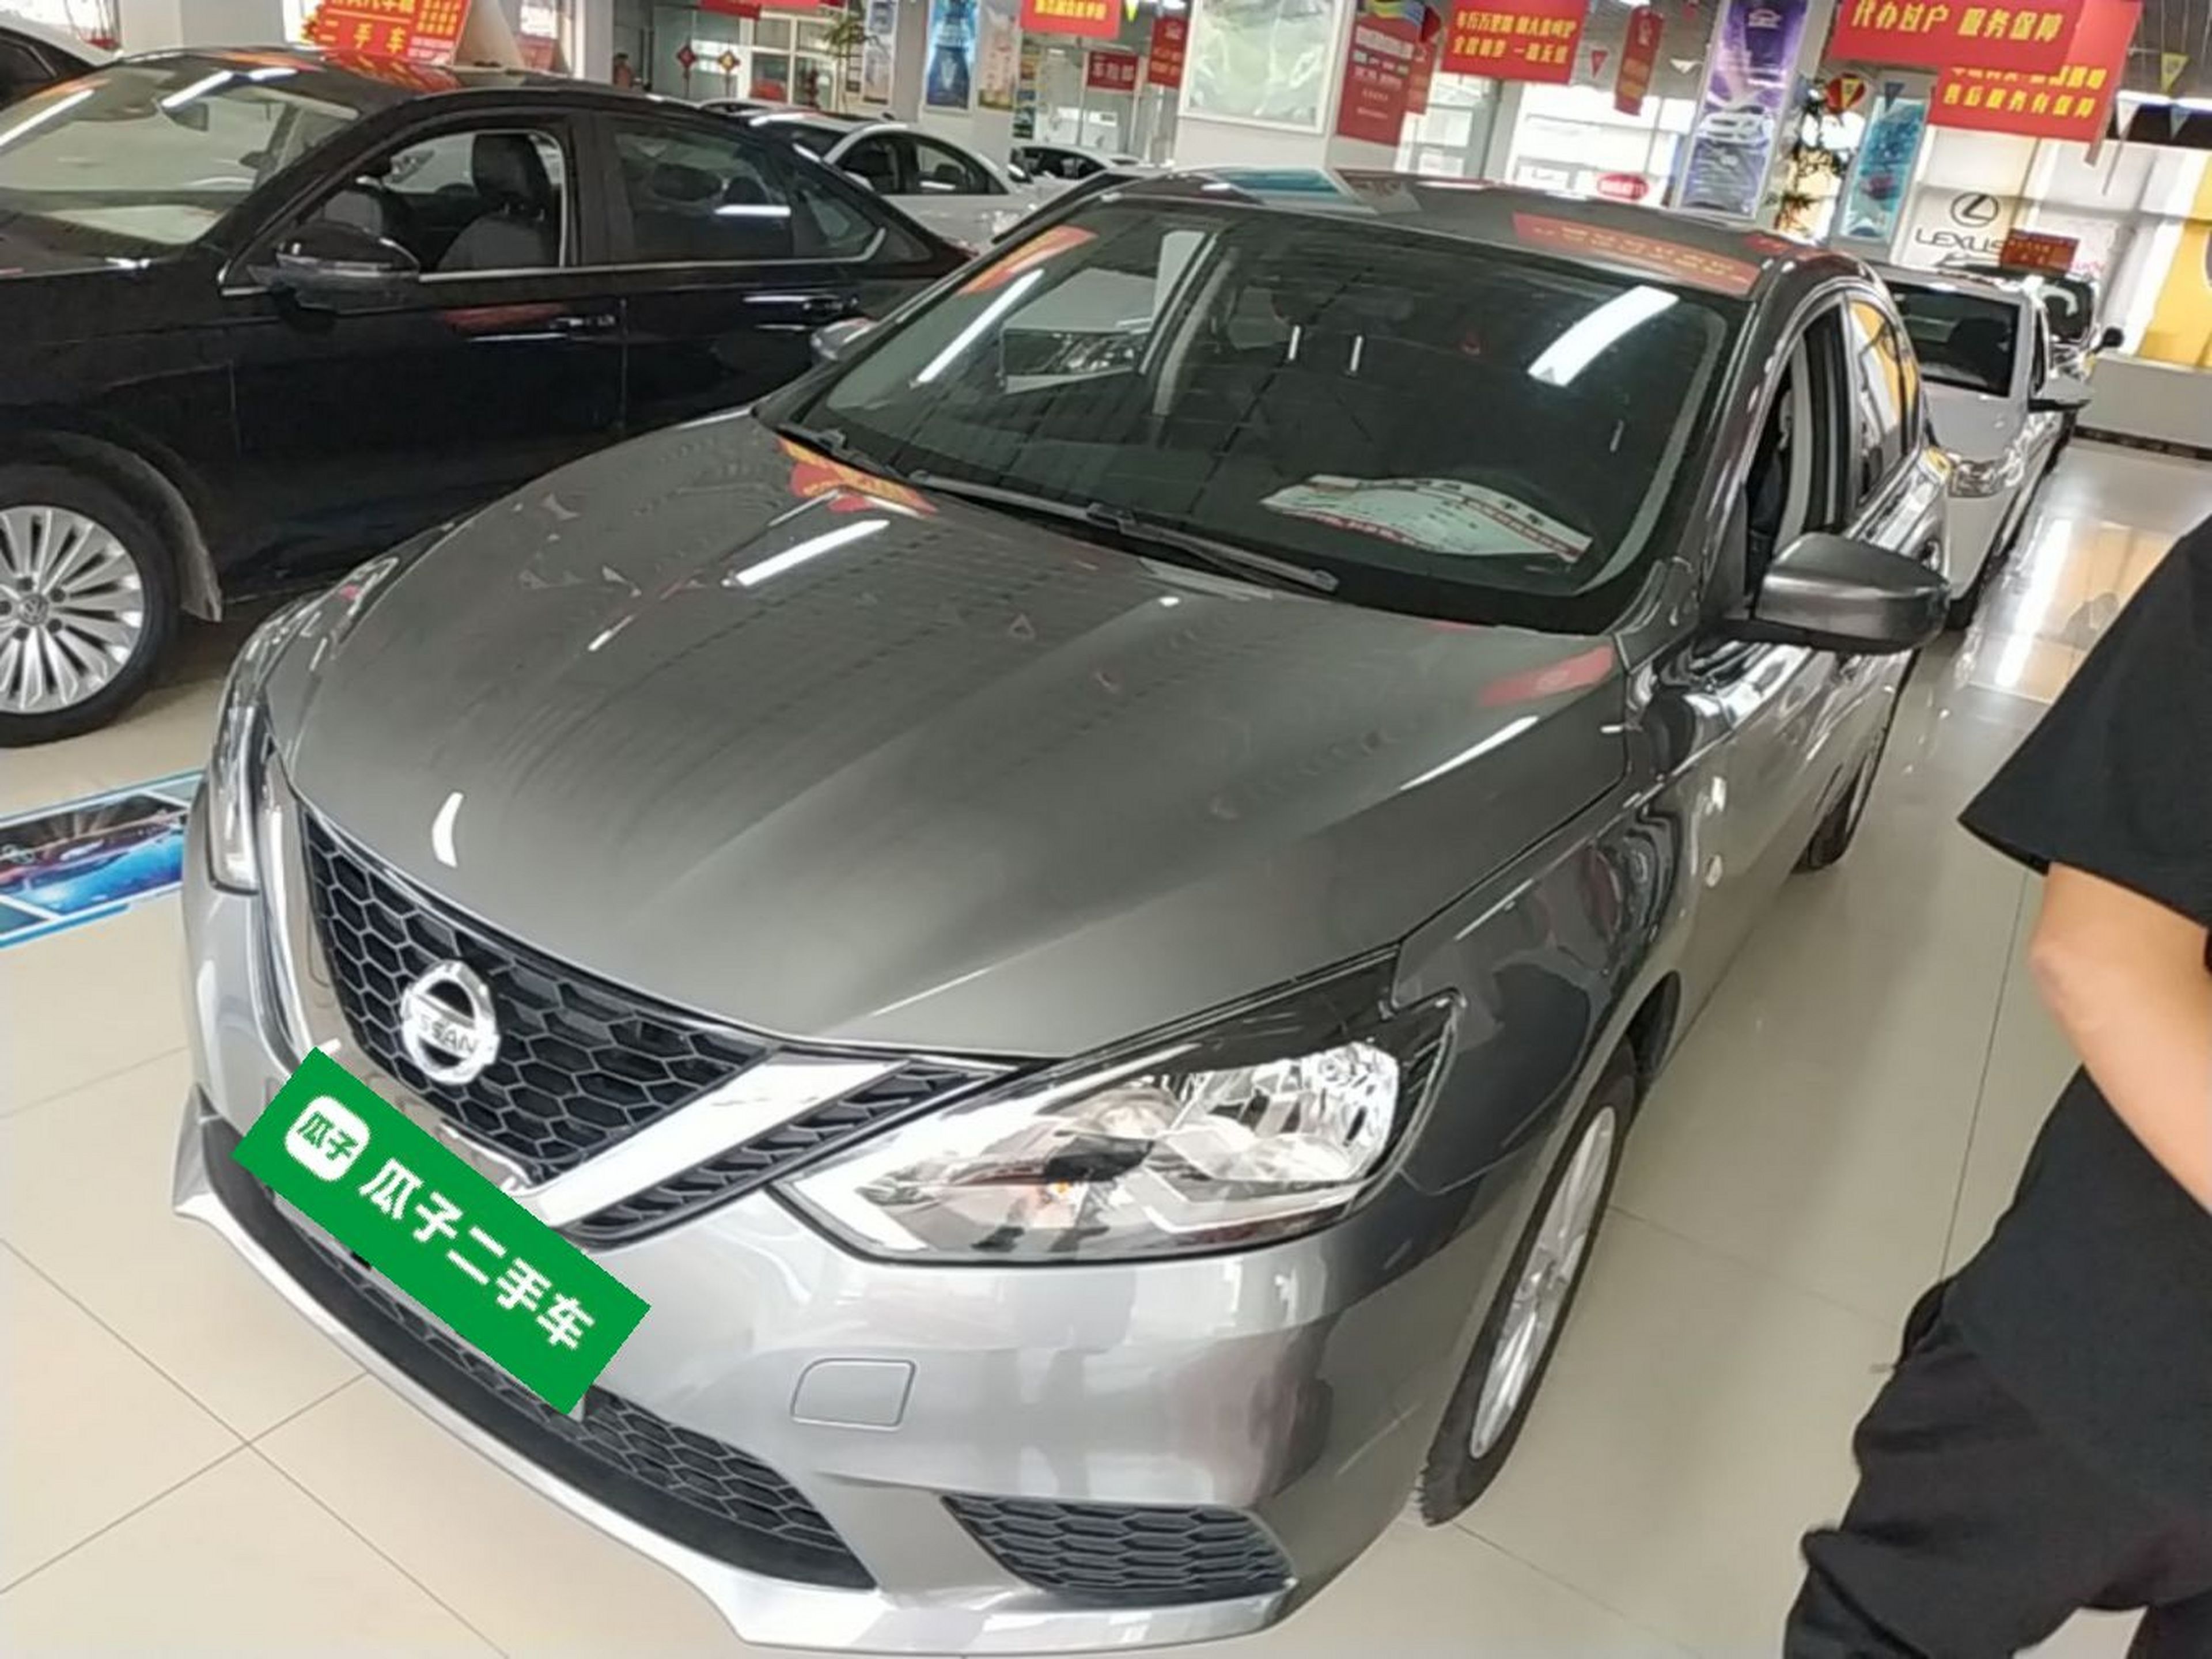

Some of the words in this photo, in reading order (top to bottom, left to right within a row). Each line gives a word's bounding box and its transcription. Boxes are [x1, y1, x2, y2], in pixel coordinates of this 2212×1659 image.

[319, 20, 406, 54] 二手车
[1957, 7, 2063, 42] 服务保障
[1915, 228, 2005, 254] LEXUS
